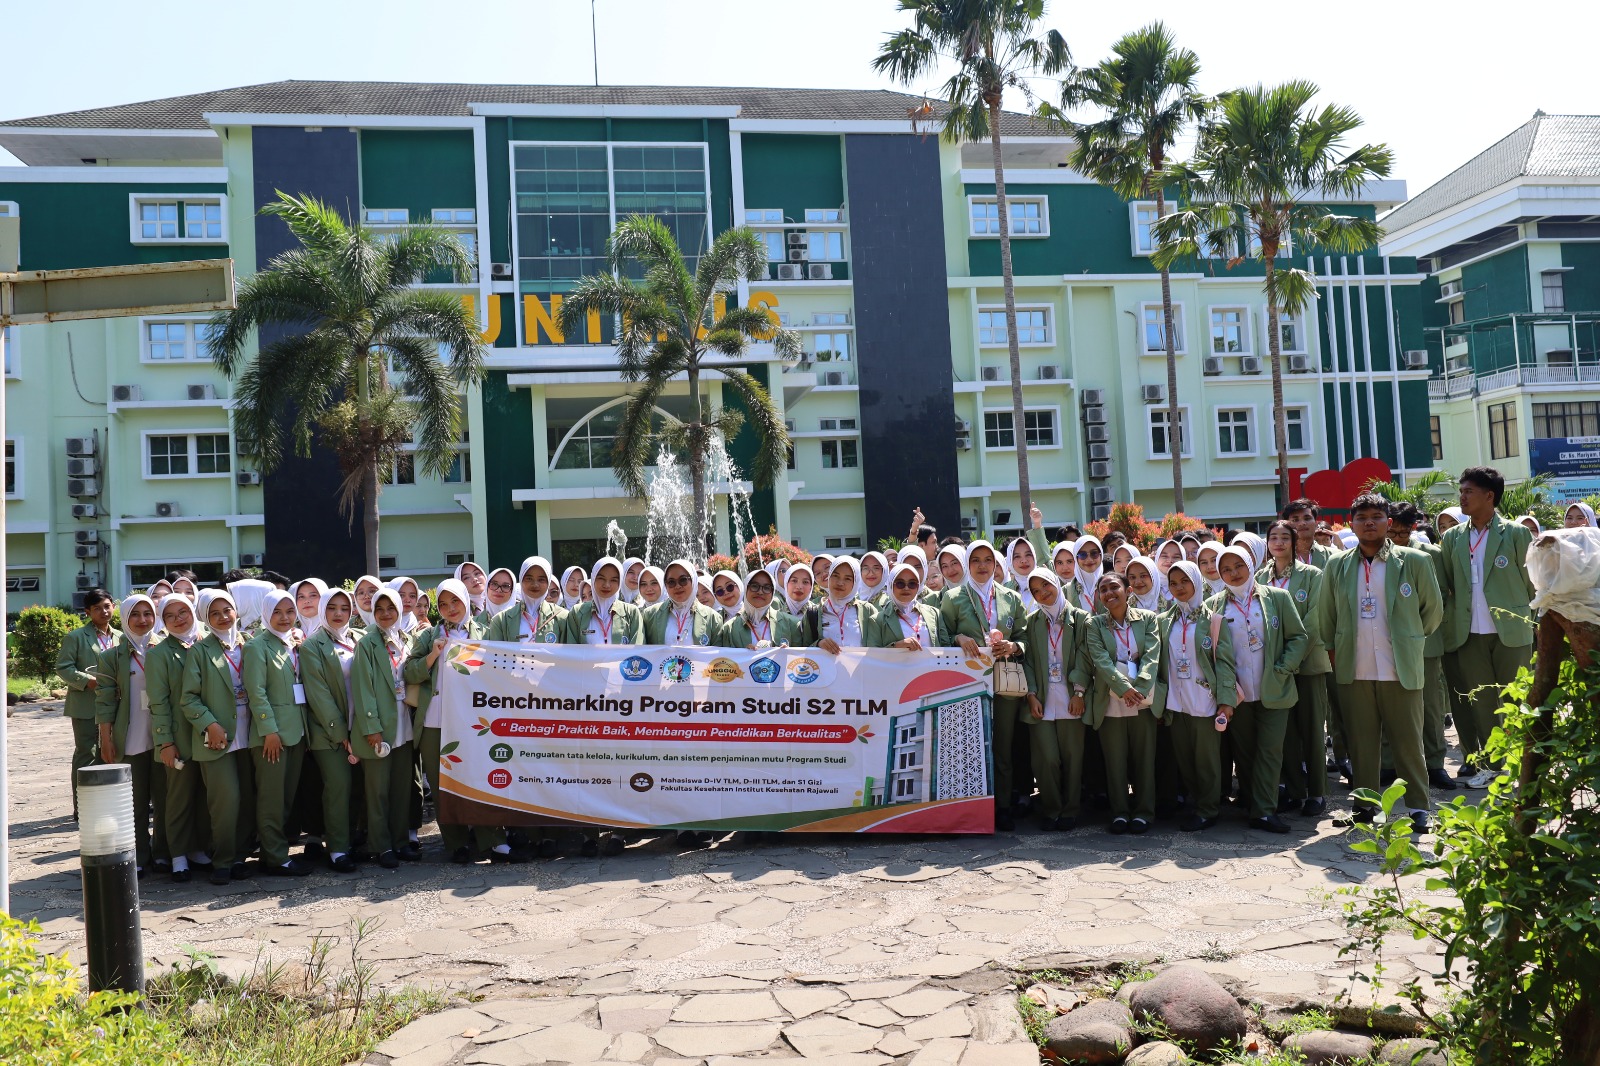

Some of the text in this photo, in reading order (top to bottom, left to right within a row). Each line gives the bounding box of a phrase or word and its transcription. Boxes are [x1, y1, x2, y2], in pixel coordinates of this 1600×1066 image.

[461, 291, 783, 344] UNIS
[472, 691, 888, 717] Benchmarking Program Studi S2 TLM
[509, 723, 556, 735] Berbagi
[557, 724, 600, 735] Praktik
[602, 725, 631, 737] Baik,
[634, 726, 707, 738] Membangun
[710, 727, 774, 738] Pendidikan
[519, 750, 565, 760] Penguatan
[586, 752, 614, 761] kelola,
[615, 753, 661, 761] kurikulum,
[680, 754, 709, 762] sistem
[710, 755, 760, 763] penjaminan
[786, 756, 822, 764] Program
[518, 775, 544, 784] Senin,
[556, 777, 590, 785] Agustus
